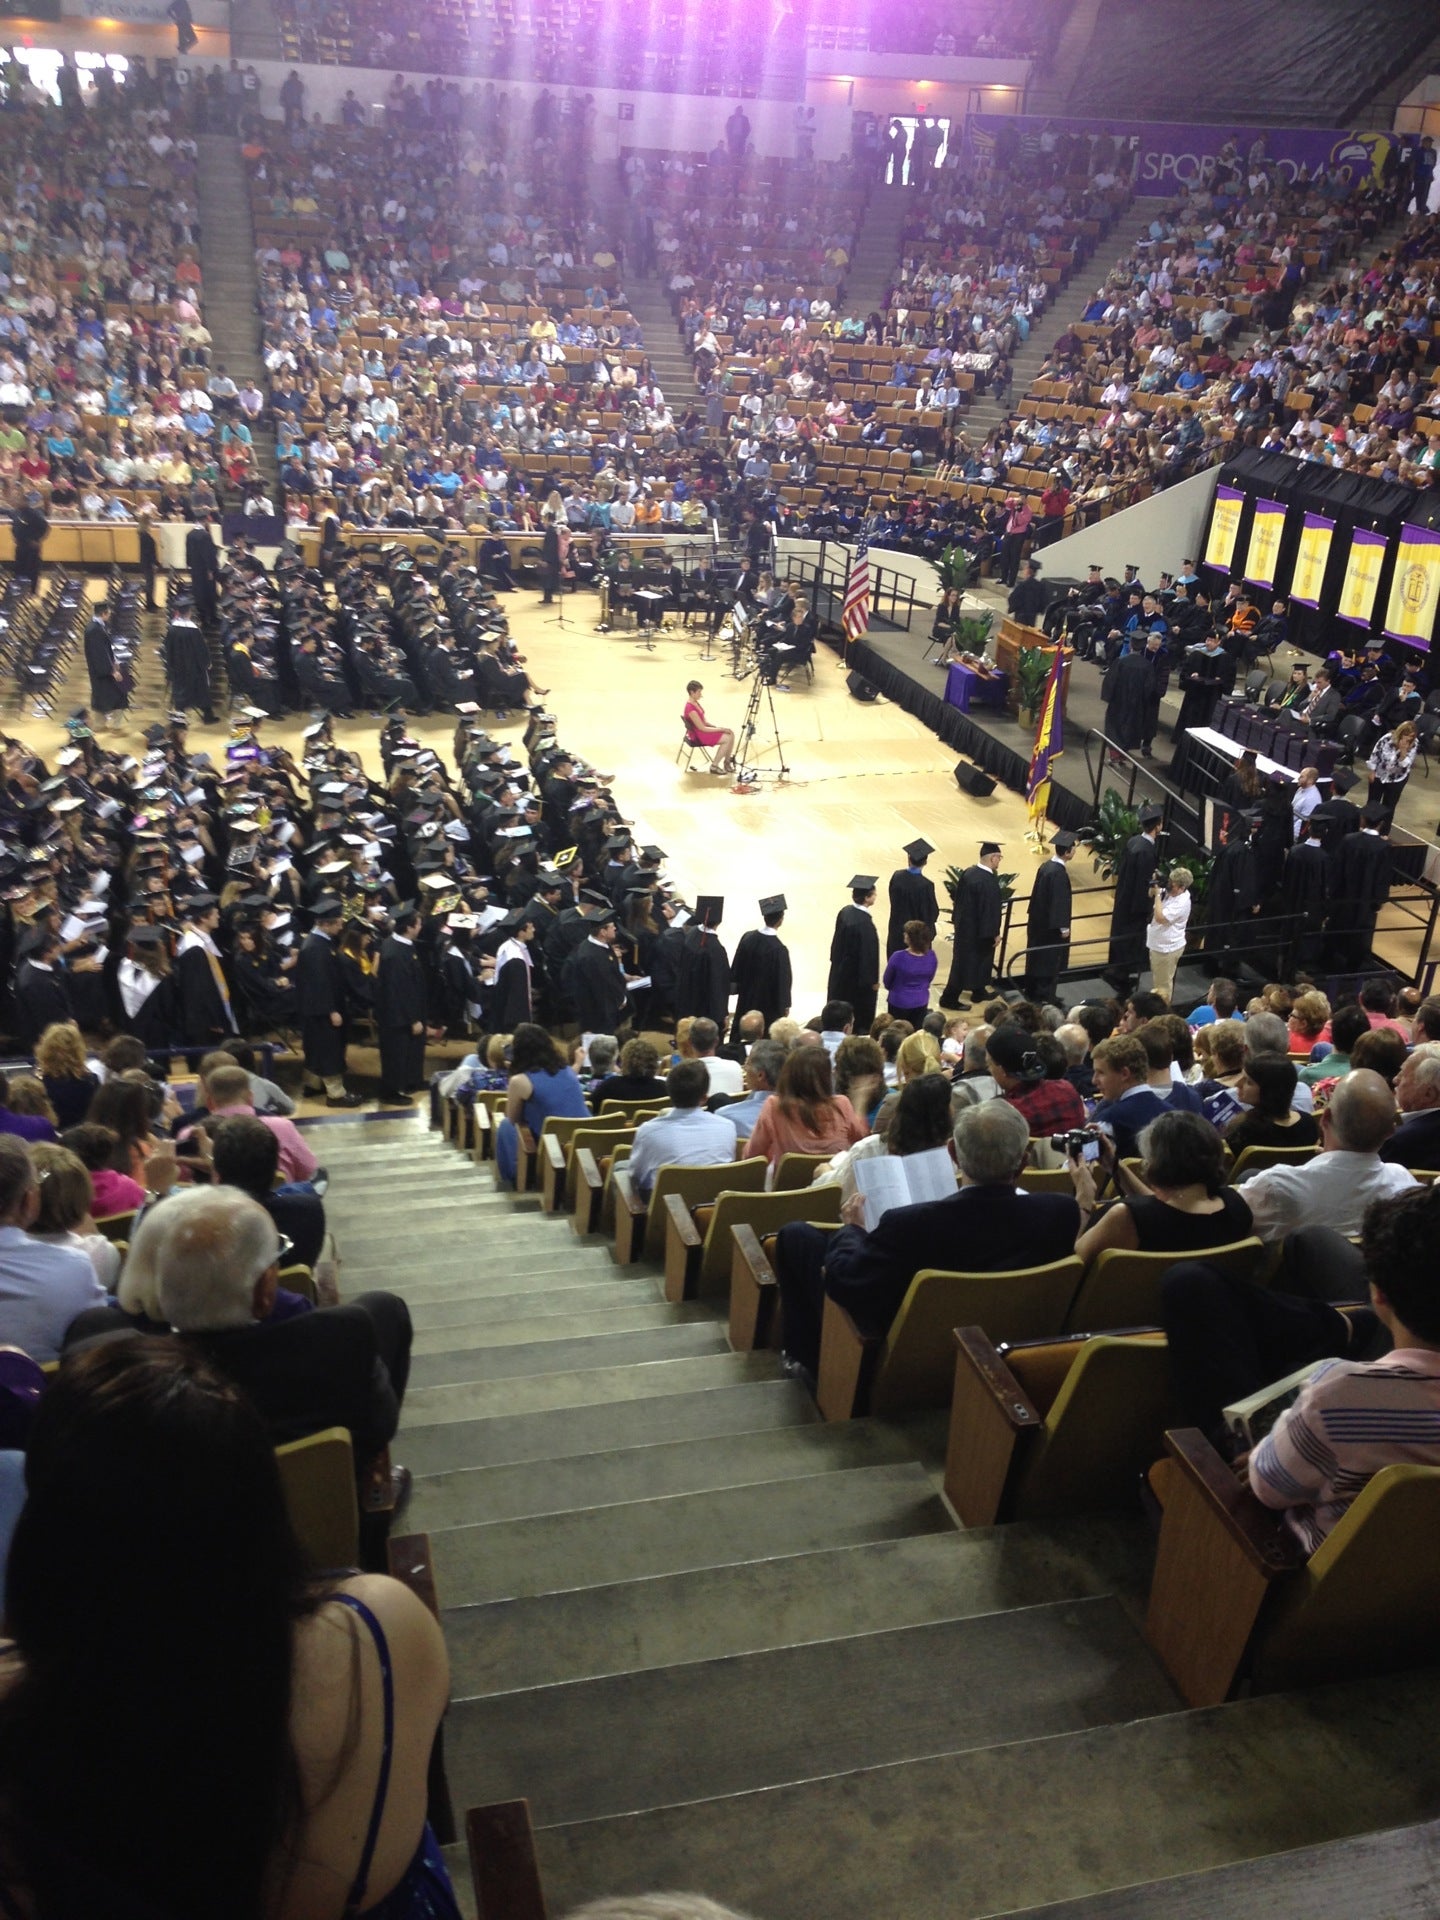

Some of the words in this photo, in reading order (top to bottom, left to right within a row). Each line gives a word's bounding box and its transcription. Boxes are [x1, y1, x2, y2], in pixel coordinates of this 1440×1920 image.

[244, 75, 256, 90] E
[560, 100, 571, 113] E
[621, 104, 632, 119] F
[866, 122, 875, 135] F
[1129, 136, 1140, 150] F
[1401, 147, 1412, 163] F
